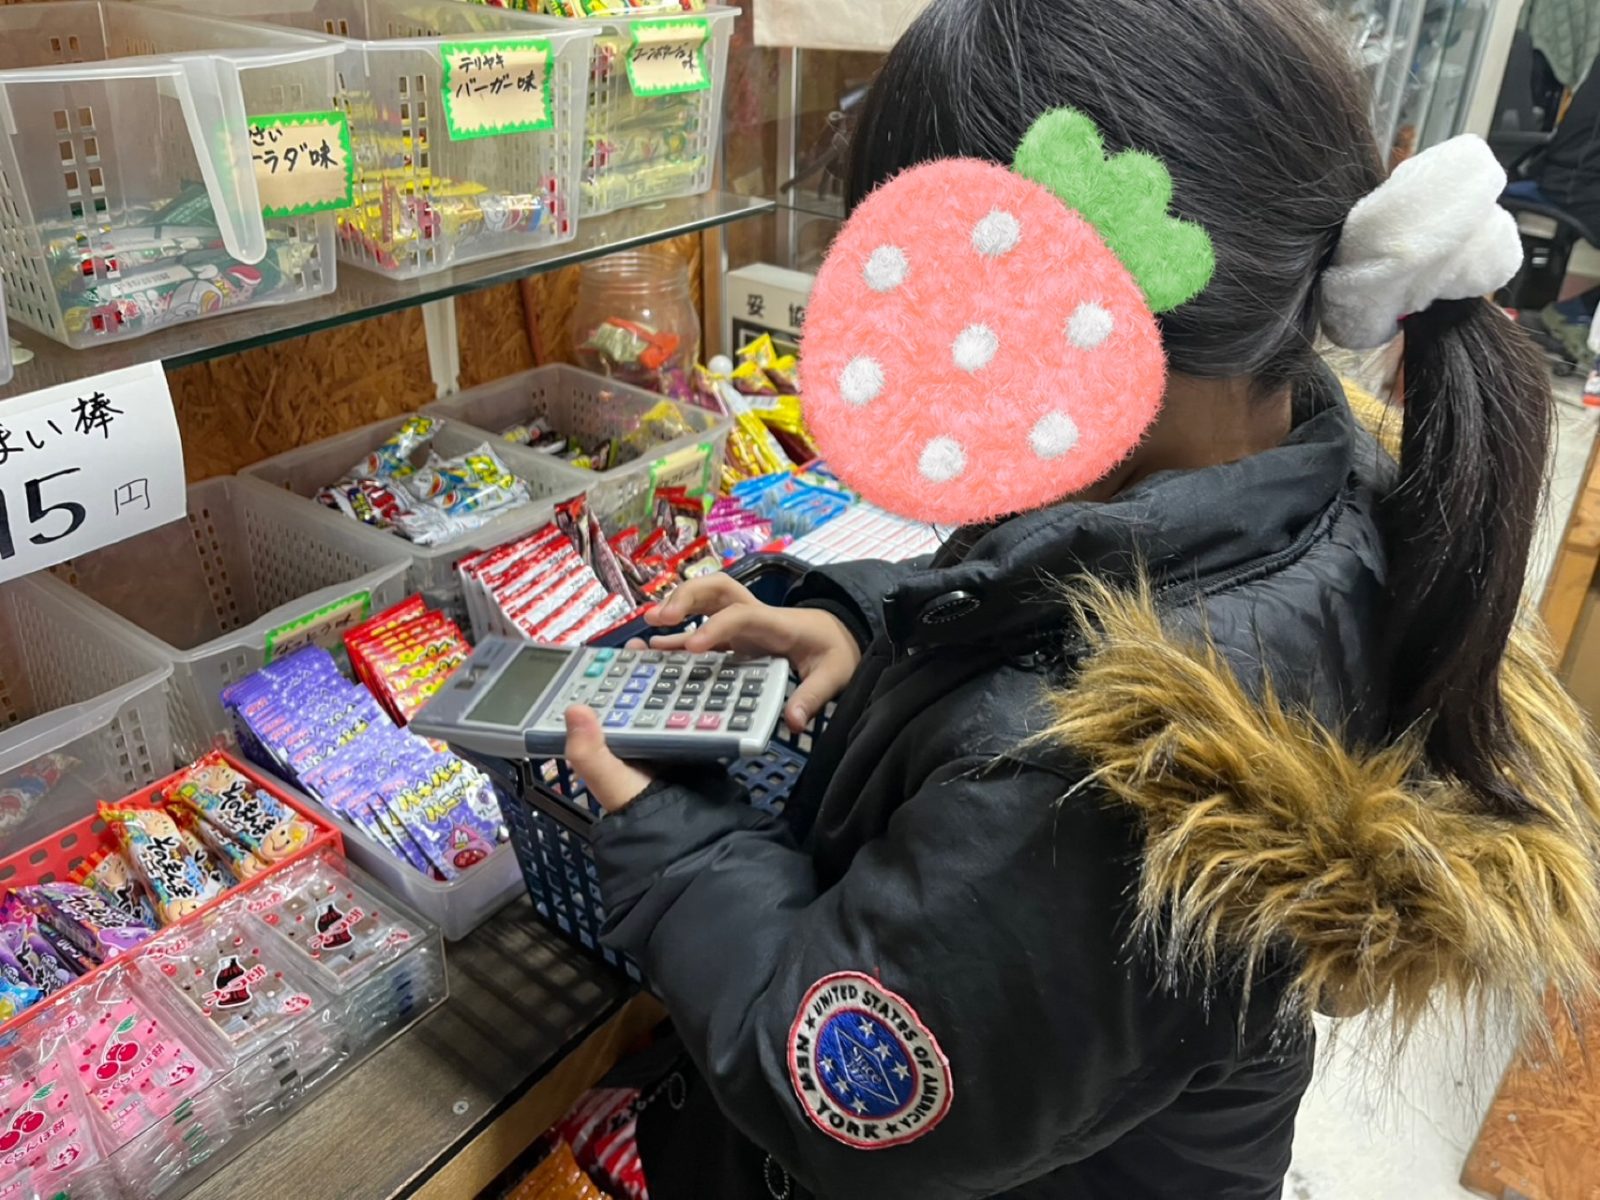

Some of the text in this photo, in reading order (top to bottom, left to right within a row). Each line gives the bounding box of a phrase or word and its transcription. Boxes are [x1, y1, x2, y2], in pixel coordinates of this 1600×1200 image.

[458, 53, 505, 73] テリヤキ
[455, 69, 538, 98] バーガー味
[248, 126, 284, 147] さい
[114, 478, 151, 516] 円
[813, 985, 858, 1015] UNITED
[861, 990, 919, 1042] STATES
[914, 1046, 934, 1070] OF
[816, 1098, 880, 1139] YORK
[0, 1118, 66, 1166] くらんぼ餅
